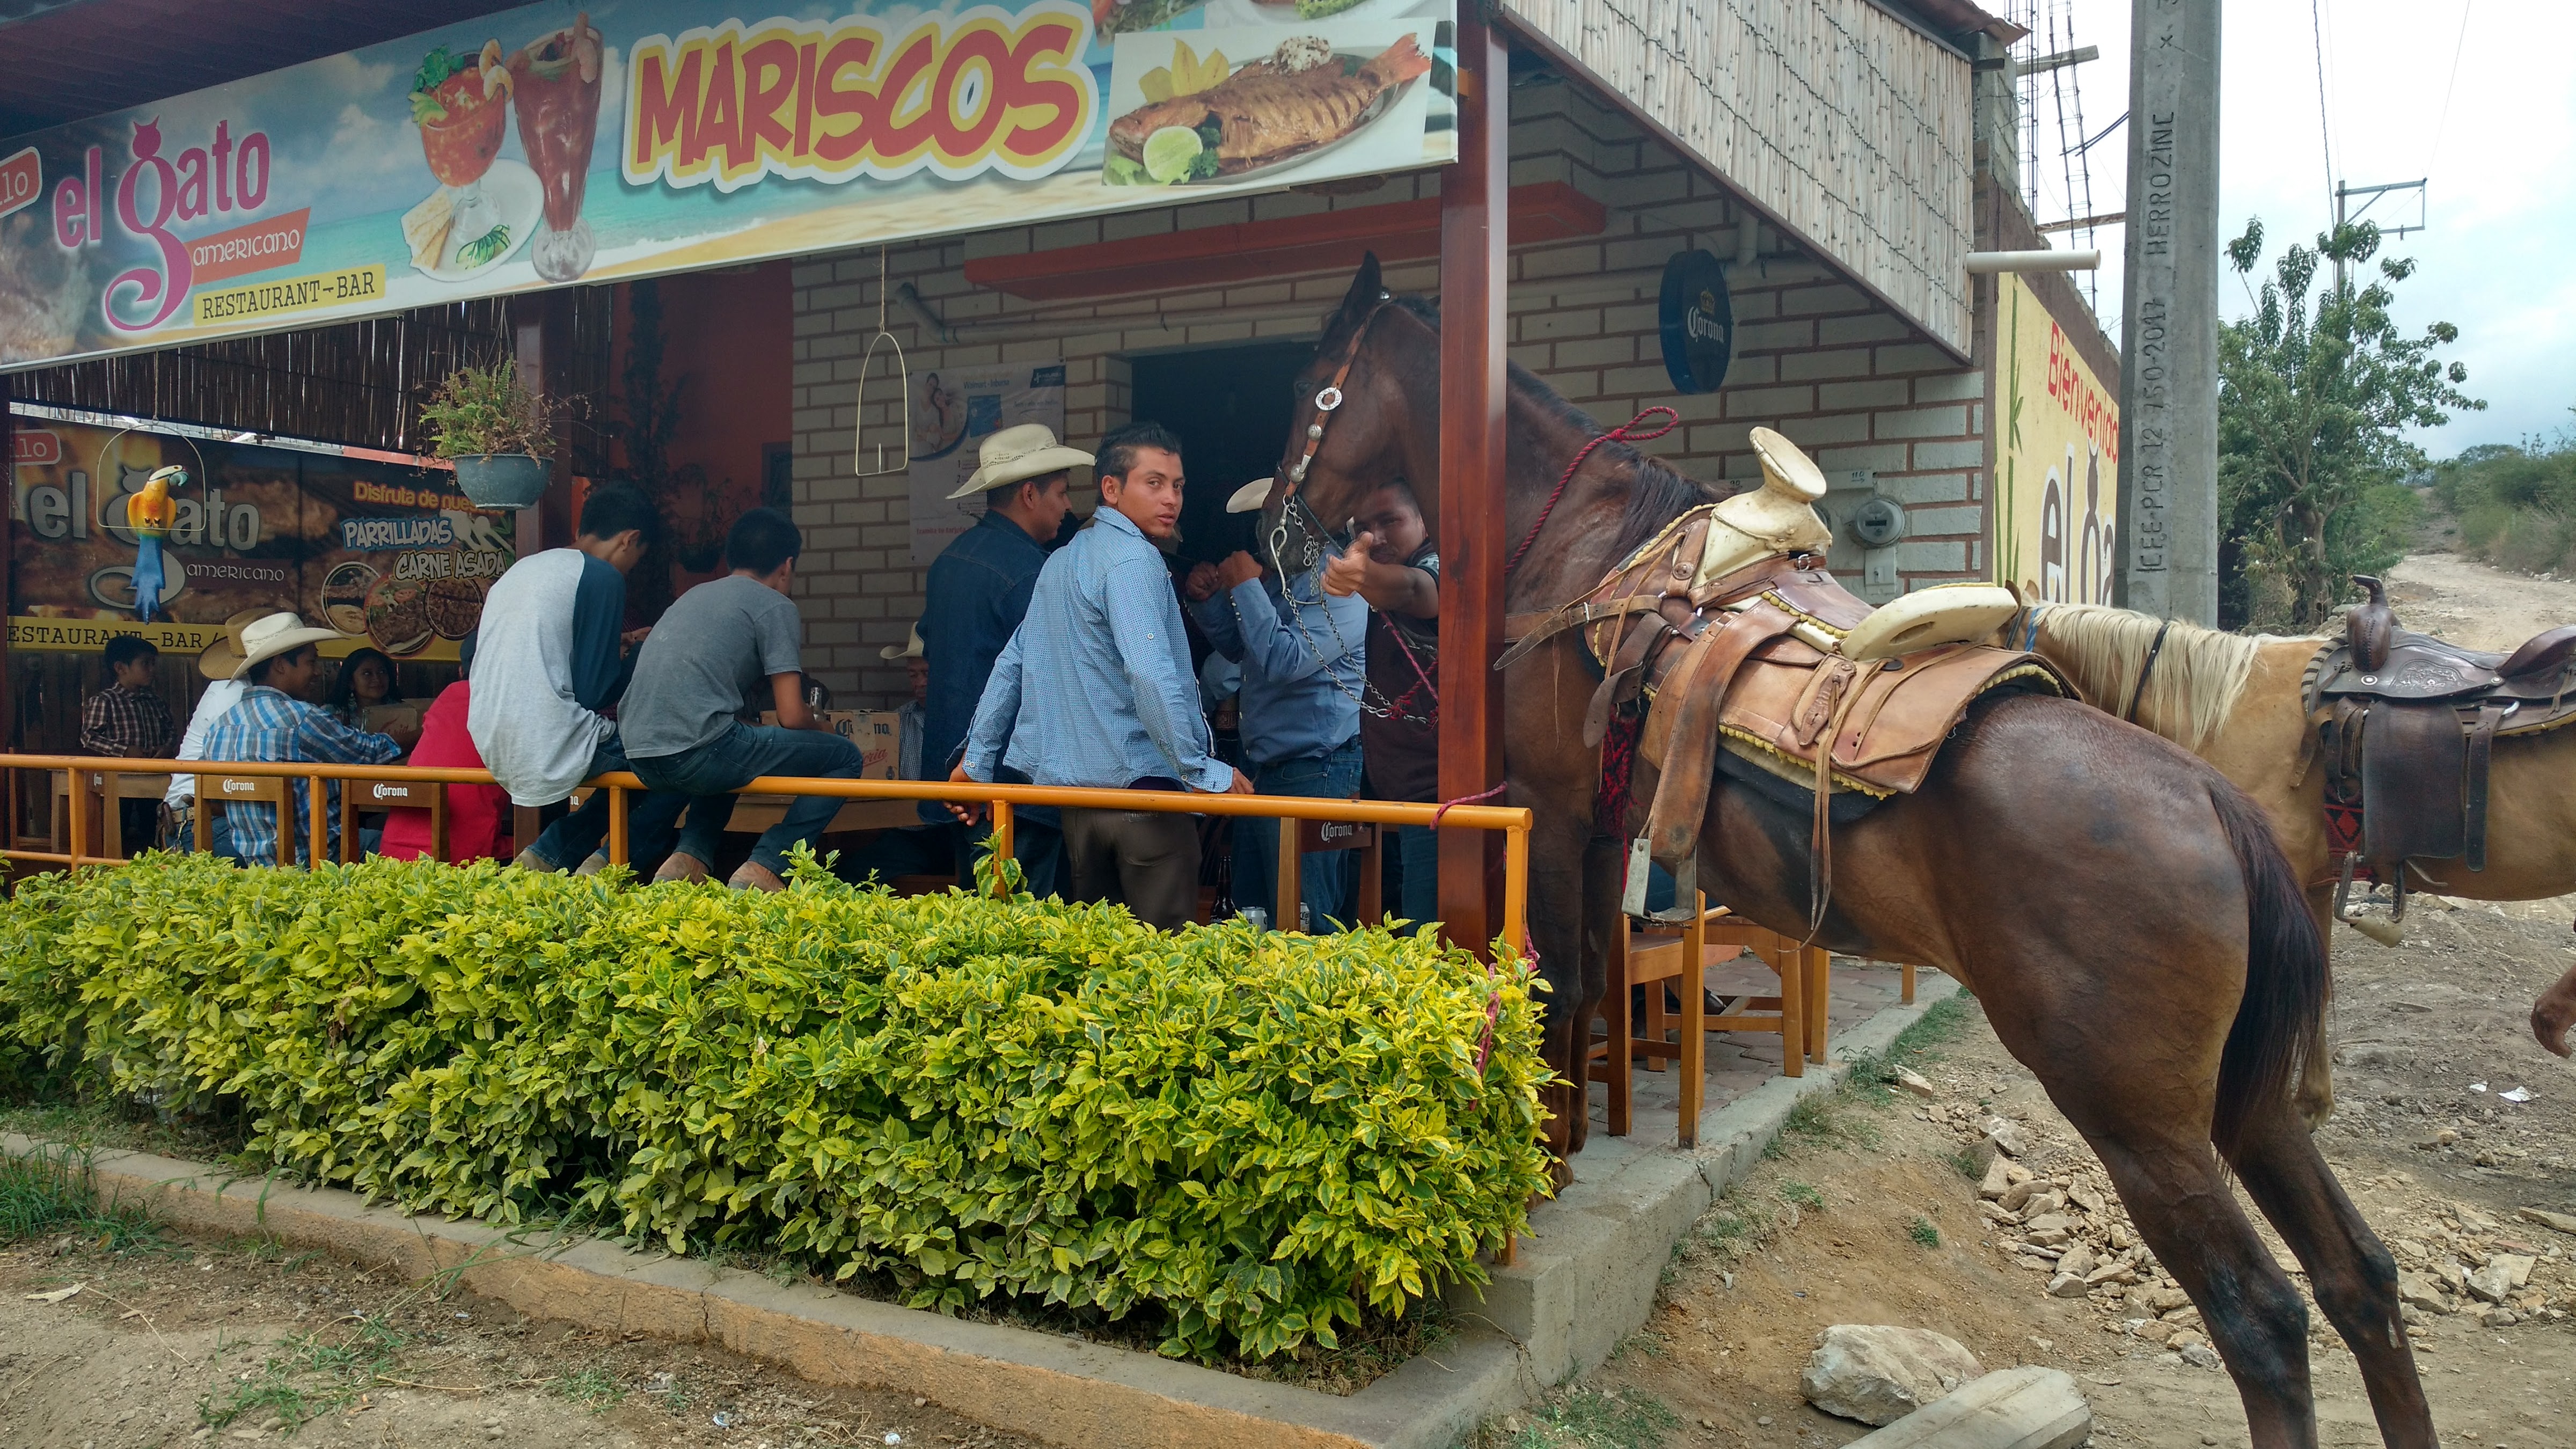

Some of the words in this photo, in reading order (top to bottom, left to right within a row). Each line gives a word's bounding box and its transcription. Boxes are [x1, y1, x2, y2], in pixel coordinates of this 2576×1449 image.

[636, 23, 1080, 171] MARISCOS
[55, 147, 101, 247] el
[105, 115, 270, 331] gato
[193, 228, 301, 266] americano
[1687, 306, 1724, 344] Corona
[30, 471, 87, 538] el
[355, 482, 415, 505] Disfruta
[418, 490, 439, 508] de
[343, 519, 452, 548] PARRILLADAS
[2041, 454, 2074, 604] el
[186, 562, 286, 582] americano
[395, 552, 453, 581] CARNE
[454, 550, 508, 580] ASADA
[222, 778, 255, 795] Corona
[372, 782, 408, 800] Corona
[1321, 821, 1352, 842] Corona
